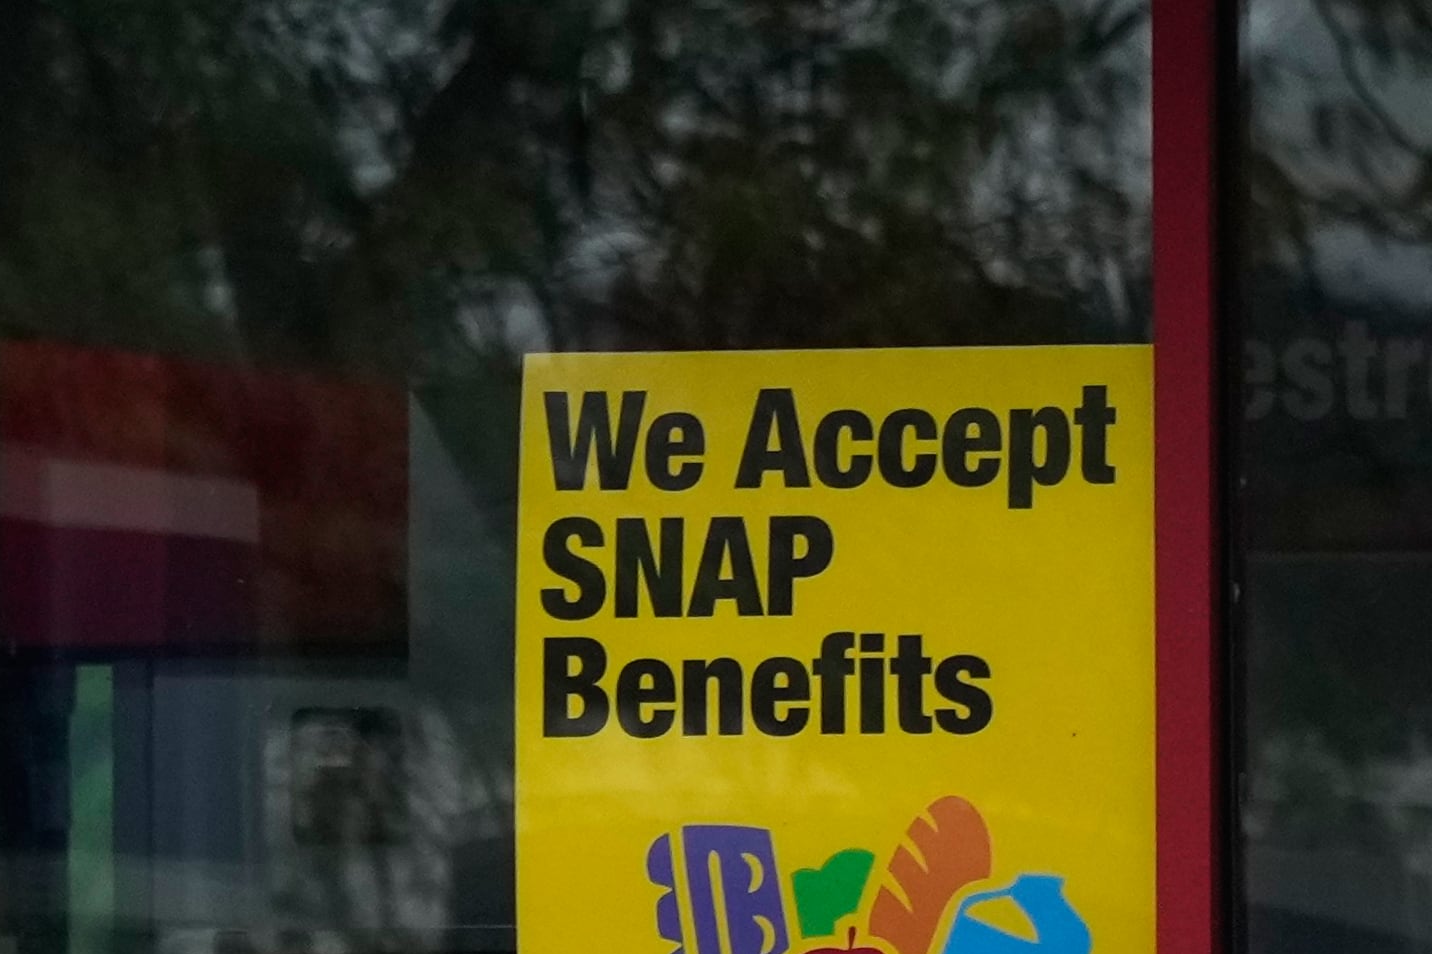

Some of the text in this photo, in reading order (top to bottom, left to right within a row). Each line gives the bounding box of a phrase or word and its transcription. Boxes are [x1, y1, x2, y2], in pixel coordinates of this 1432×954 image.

[543, 384, 1117, 509] We Accept
[540, 515, 834, 620] SNAP
[543, 631, 994, 739] Benefits
